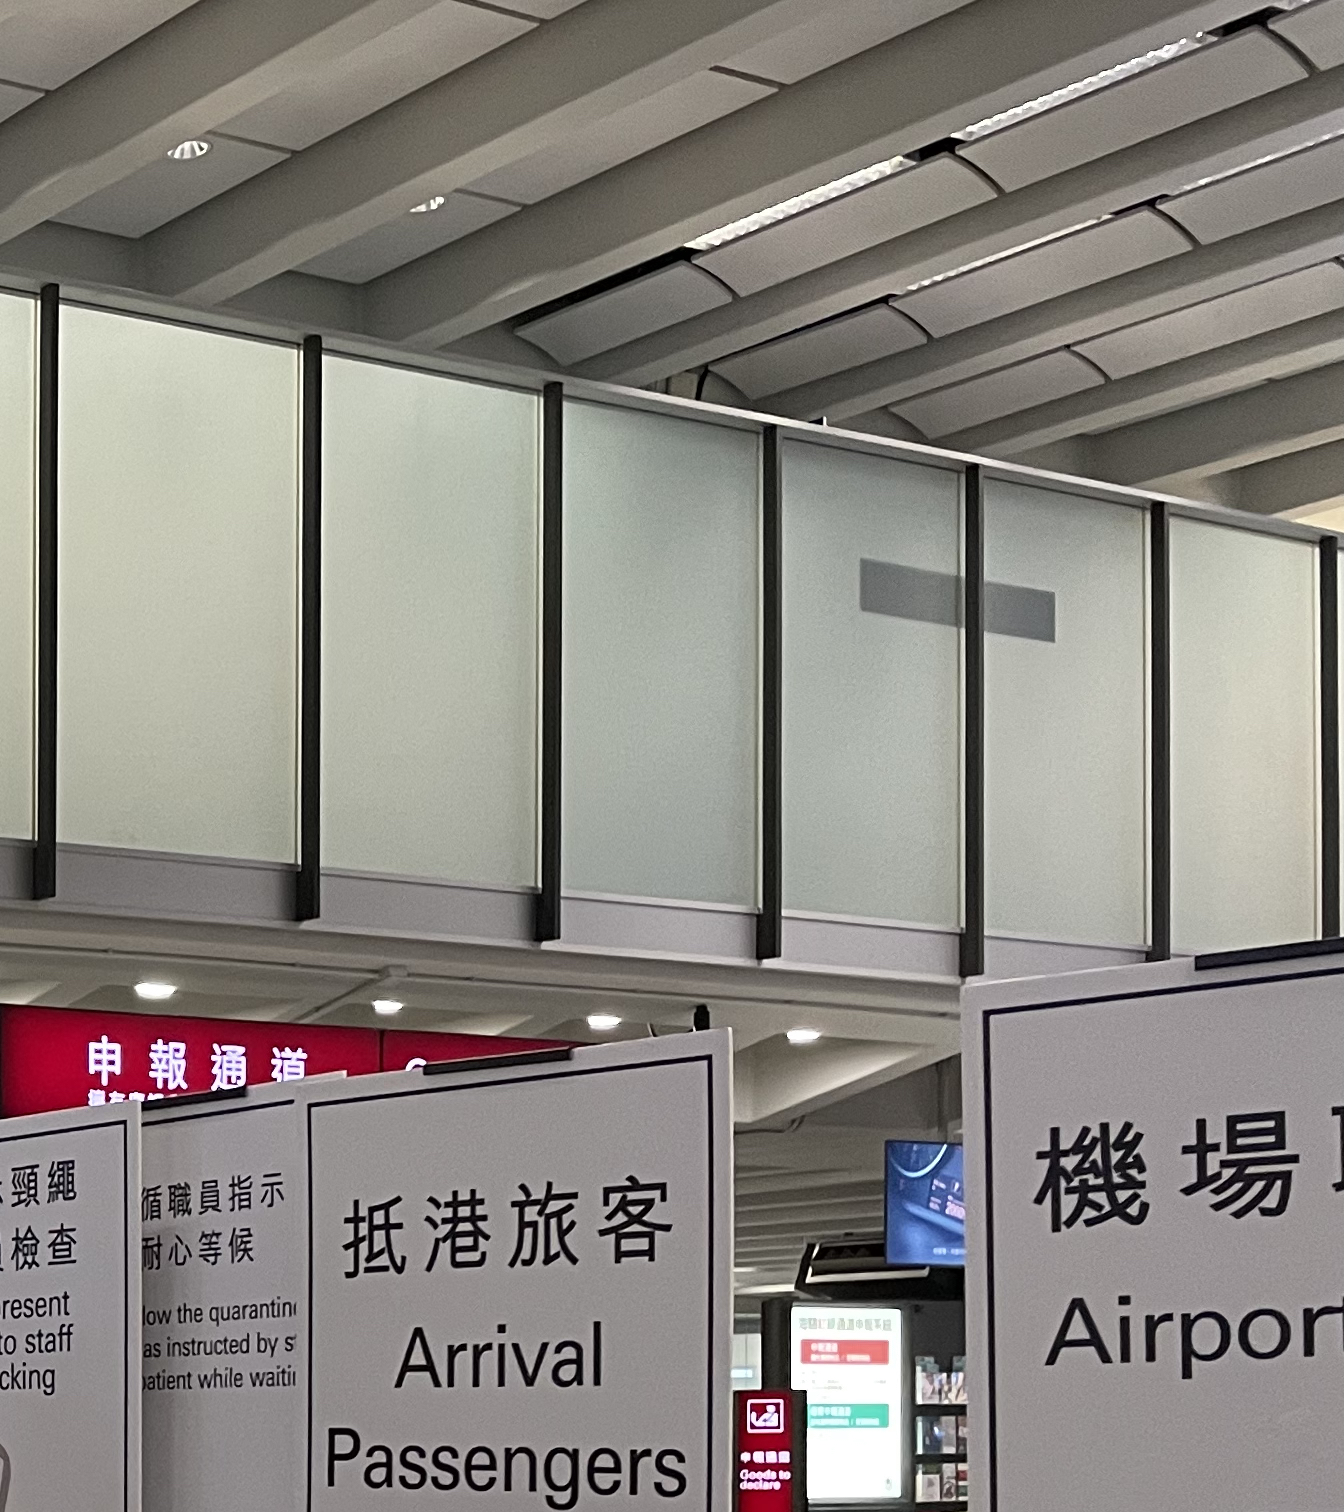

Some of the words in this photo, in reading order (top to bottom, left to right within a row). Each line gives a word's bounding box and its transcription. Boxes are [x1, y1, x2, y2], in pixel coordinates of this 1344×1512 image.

[88, 1035, 308, 1091] 申報通道
[1033, 1106, 1344, 1233] 機場
[141, 1227, 254, 1271] 耐心等候
[342, 1175, 673, 1279] 抵港旅客
[25, 1323, 74, 1354] staff
[142, 1304, 172, 1326] low
[177, 1302, 204, 1324] the
[1045, 1295, 1344, 1380] Airpor
[143, 1341, 161, 1358] as
[166, 1332, 250, 1357] instructed
[257, 1332, 279, 1358] by
[284, 1333, 297, 1352] s
[394, 1321, 602, 1389] Arrival
[198, 1366, 244, 1389] while
[327, 1427, 687, 1511] Passengers
[779, 1470, 791, 1480] to
